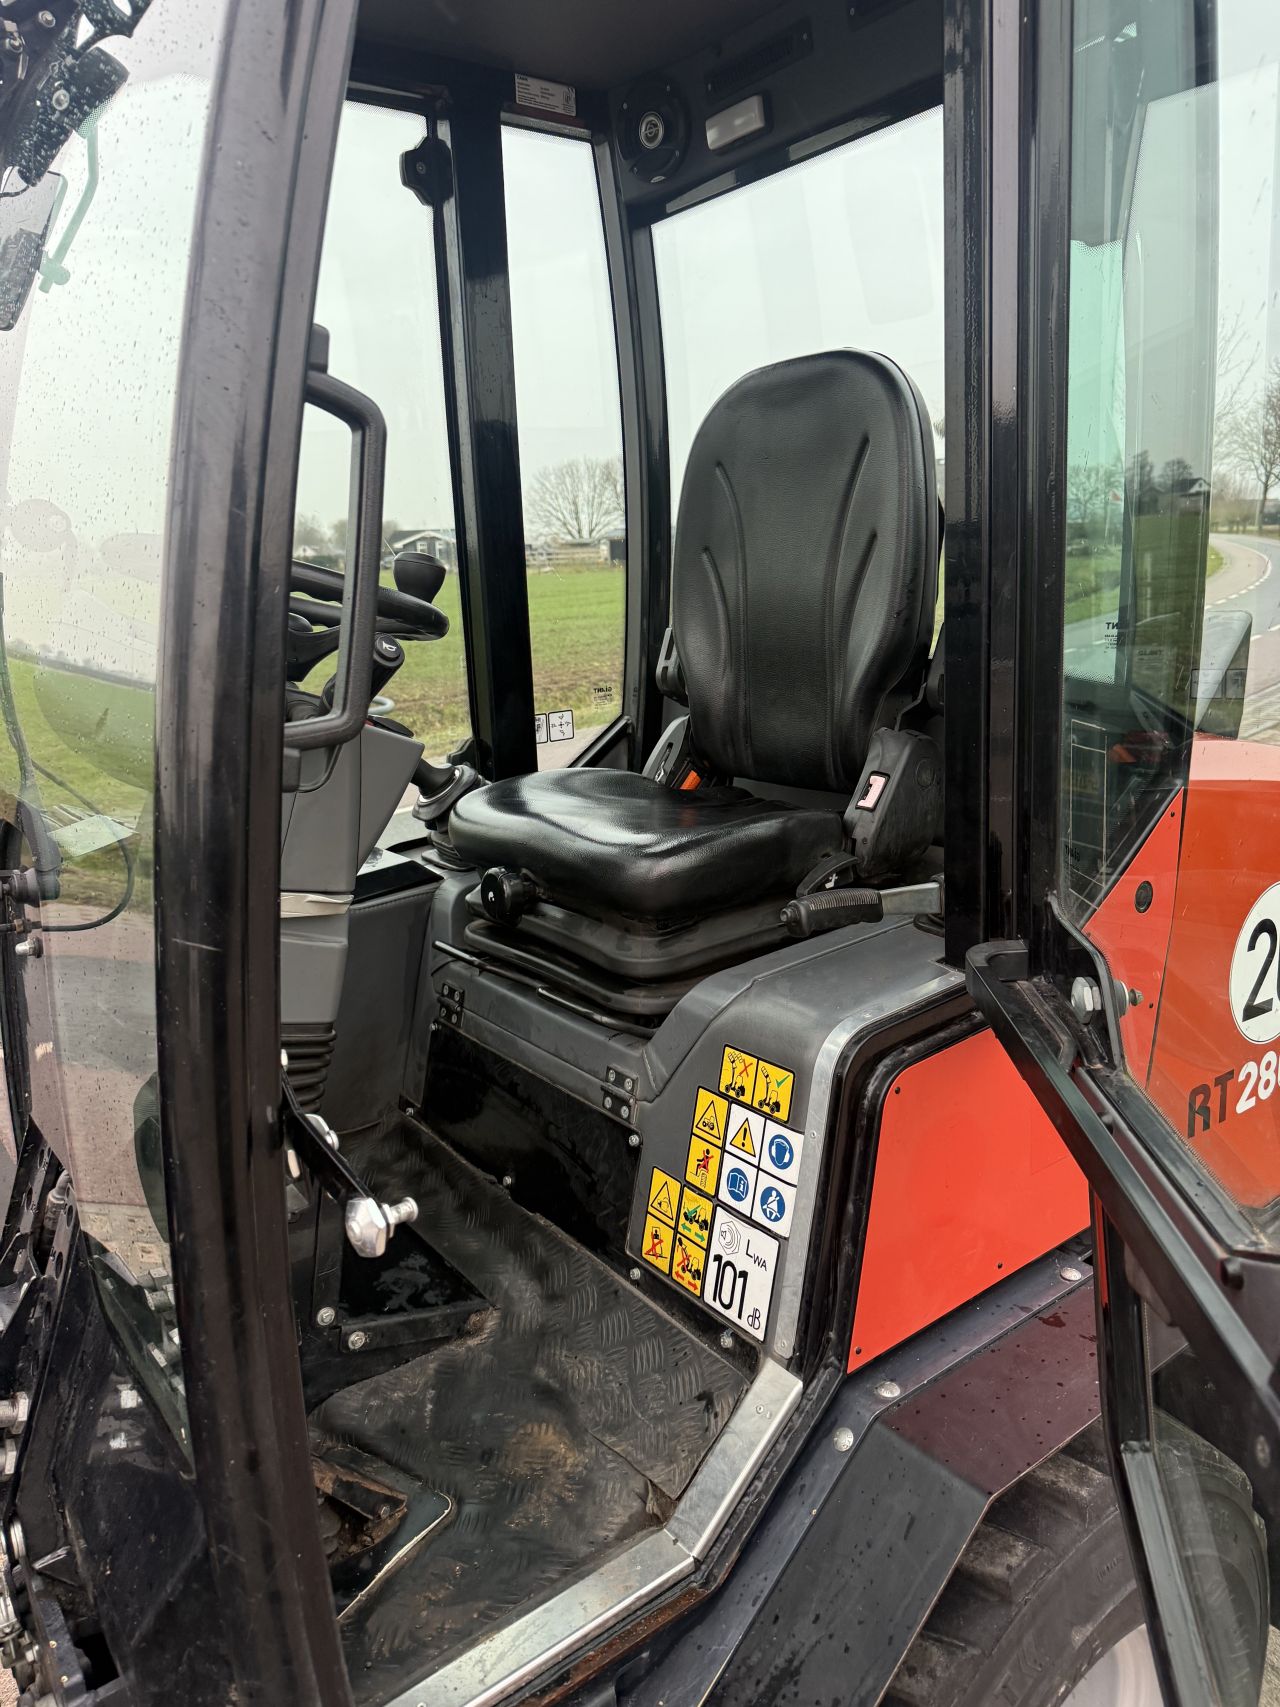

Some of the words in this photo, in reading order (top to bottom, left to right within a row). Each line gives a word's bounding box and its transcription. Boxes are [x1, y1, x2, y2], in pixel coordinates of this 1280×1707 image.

[1241, 918, 1280, 1022] 2
[1187, 1051, 1280, 1138] RT28
[713, 1254, 748, 1320] 101
[747, 1307, 760, 1330] dB
